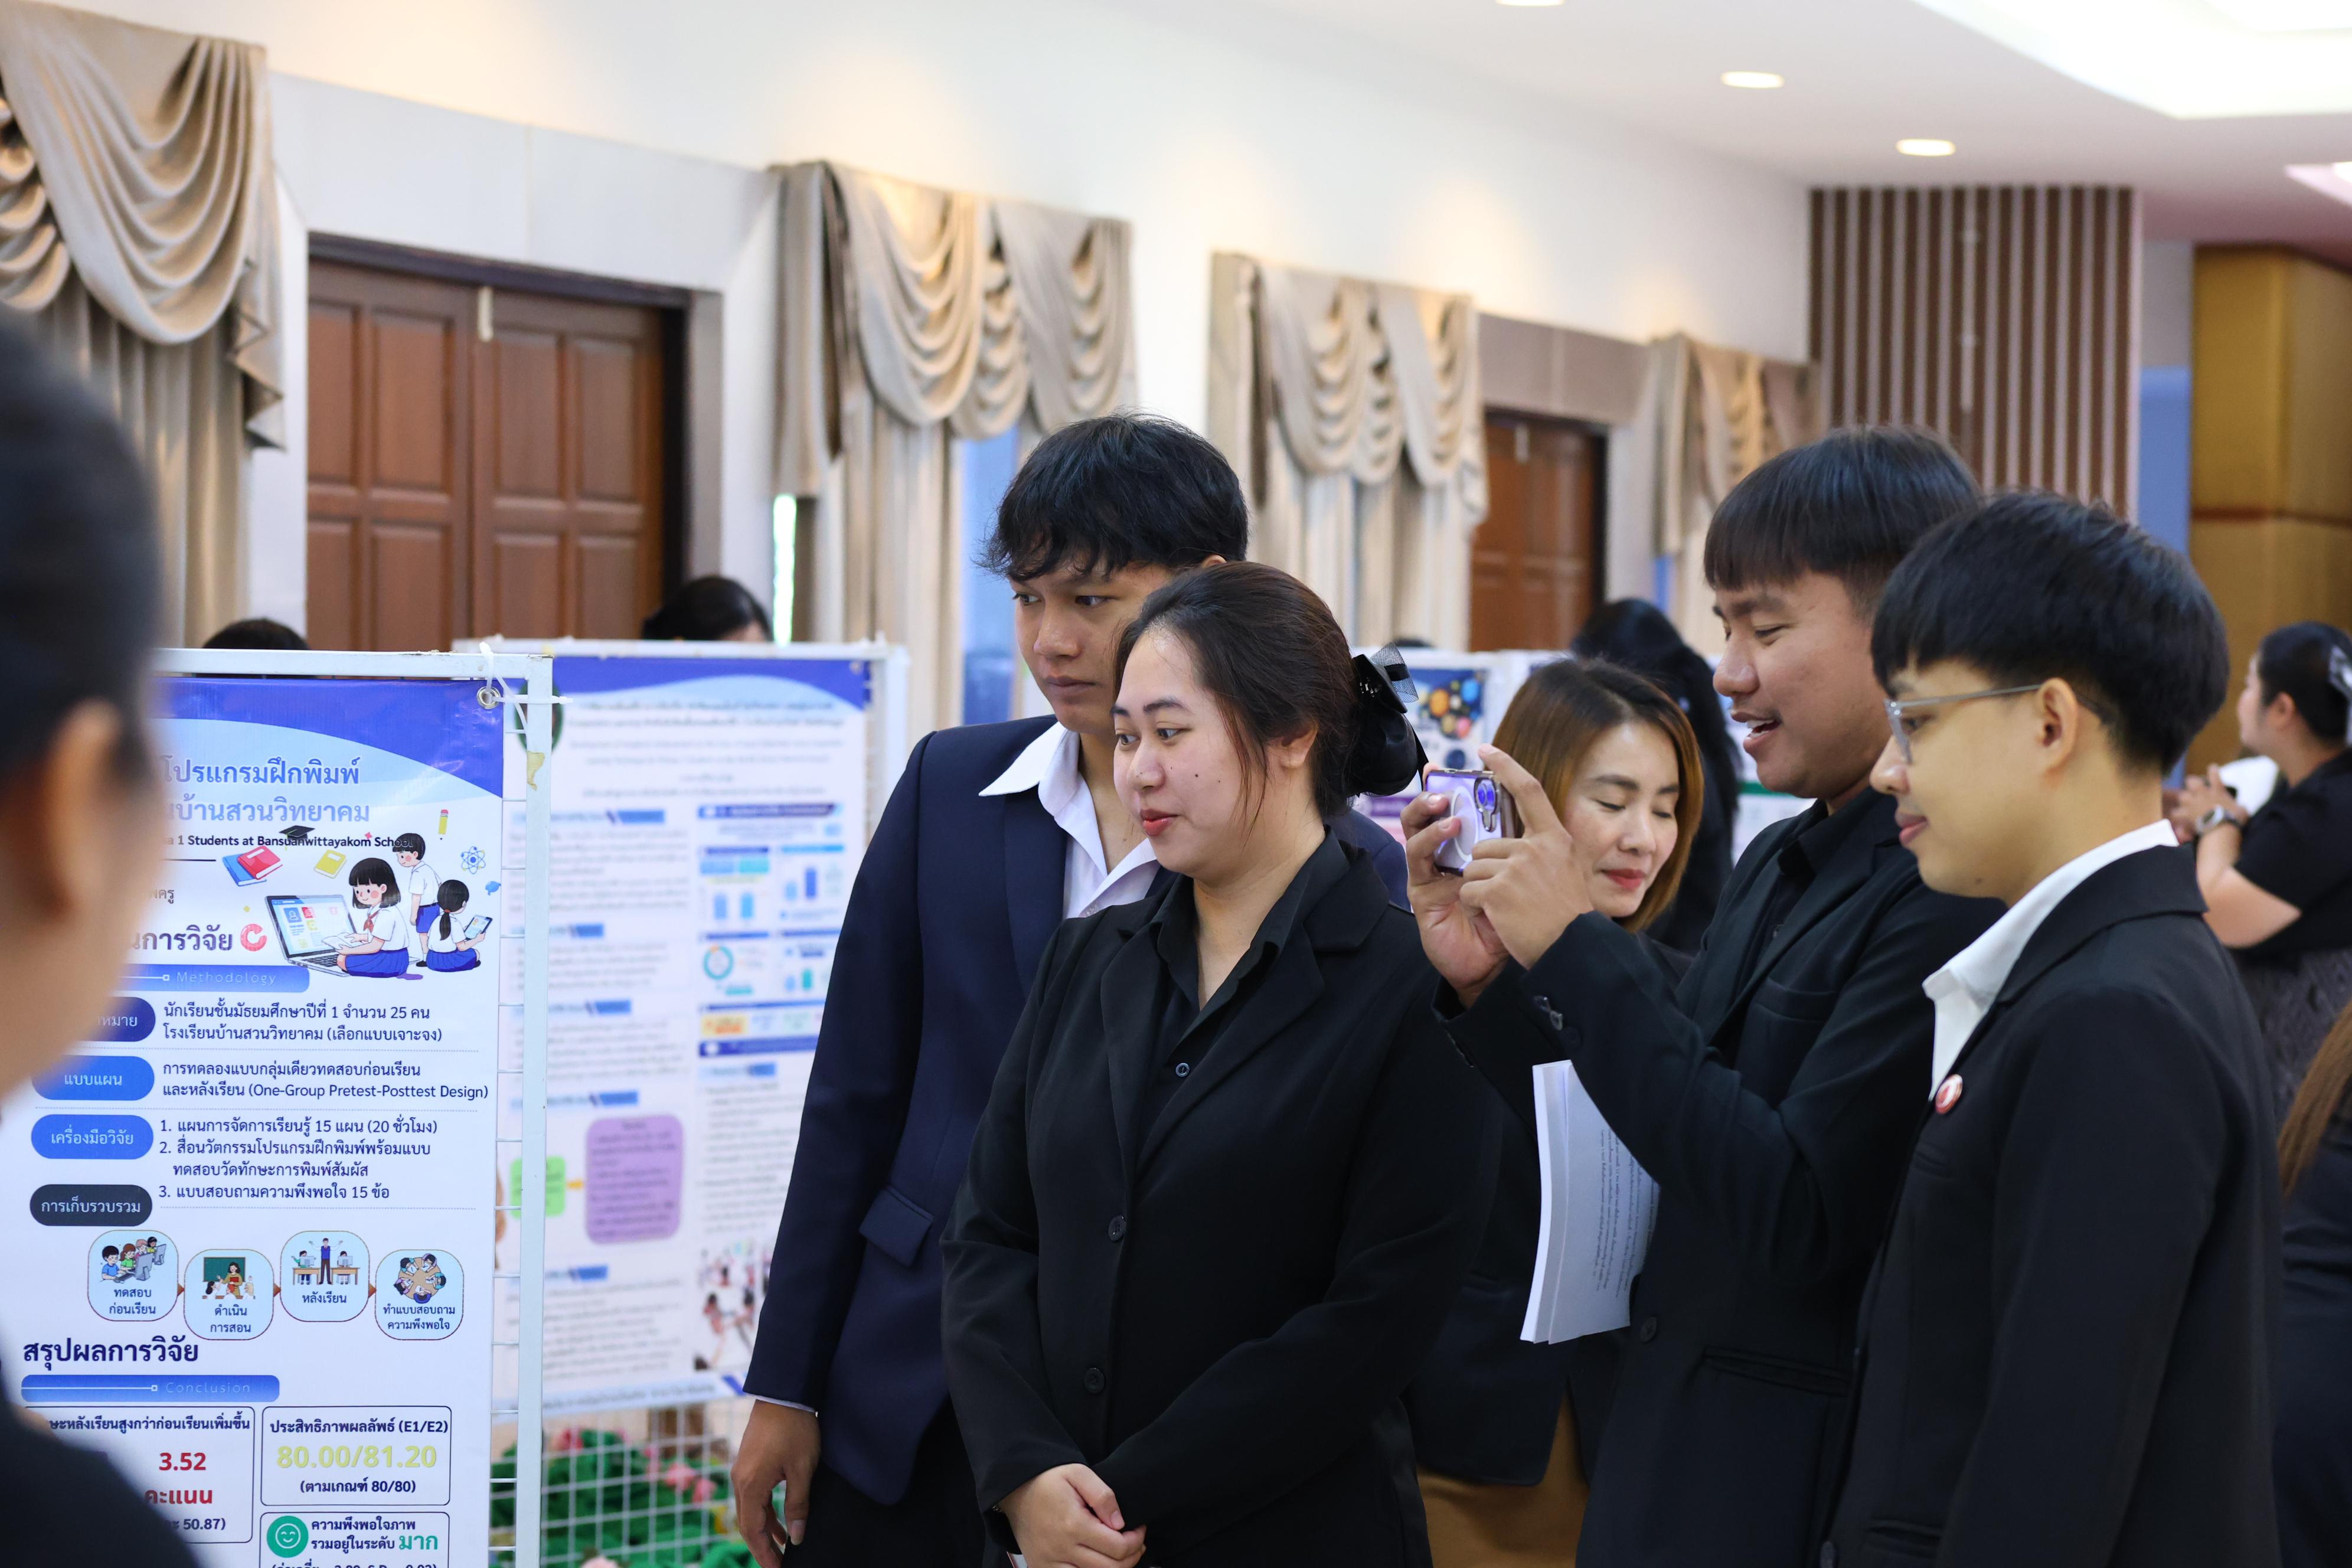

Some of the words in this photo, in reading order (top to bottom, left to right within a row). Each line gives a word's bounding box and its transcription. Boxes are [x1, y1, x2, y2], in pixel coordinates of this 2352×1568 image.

[168, 792, 370, 822] บ้านสวนวิทยาคม
[188, 835, 239, 846] Students
[242, 836, 254, 846] at
[257, 836, 371, 848] Bansuanwittayakom
[374, 837, 413, 848] School
[177, 971, 276, 986] Methodology
[164, 997, 326, 1019] นักเรียนชั้นมัธยมศึกษาปีที่
[332, 1006, 338, 1018] 1
[343, 1003, 386, 1019] จำนวน
[391, 1006, 407, 1019] 25
[411, 1008, 430, 1019] คน
[162, 1023, 323, 1040] โรงเรียนบ้านสวนวิทยาคม
[326, 1025, 443, 1042] (เลือกแบบเจาะจง)
[163, 1060, 421, 1080] การทดลองแบบกลุ่มเดียวทดสอบก่อนเรียน
[64, 1073, 123, 1086] แบบแผน
[163, 1080, 245, 1096] และหลังเรียน
[249, 1083, 325, 1100] (One-Group
[329, 1084, 436, 1098] Pretest-Posttest
[440, 1085, 489, 1101] Design)
[161, 1120, 172, 1132] 1.
[178, 1116, 311, 1137] แผนการจัดการเรียนรู้
[316, 1120, 331, 1132] 15
[335, 1121, 364, 1133] แผน
[367, 1120, 390, 1134] (20
[393, 1113, 437, 1134] ชั่วโมง)
[51, 1124, 135, 1145] เครื่องมือวิจัย
[159, 1142, 171, 1154] 2.
[177, 1134, 431, 1155] สื่อนวัตกรรมโปรแกรมฝึกพิมพ์พร้อมแบบ
[173, 1159, 368, 1177] ทดสอบวัดทักษะการพิมพ์สัมผัส
[159, 1185, 171, 1197] 3.
[177, 1182, 347, 1198] แบบสอบถามความพึงพอใจ
[352, 1186, 368, 1198] 15
[371, 1182, 390, 1198] ข้อ
[41, 1195, 141, 1213] การเก็บรวบรวม
[113, 1288, 152, 1298] ทดสอบ
[302, 1291, 347, 1304] หลังเรียน
[109, 1302, 156, 1315] ก่อนเรียน
[214, 1304, 247, 1316] ดำเนิน
[383, 1303, 456, 1315] ทำแบบสอบถาม
[210, 1323, 251, 1333] การสอน
[387, 1318, 450, 1330] ความพึงพอใจ
[23, 1335, 199, 1371] สรุปผลการวิจัย
[165, 1381, 250, 1394] Conclusion
[50, 1411, 250, 1434] ษะหลังเรียนสูงกว่าก่อนเรียนเพิ่มขึ้น
[269, 1417, 396, 1433] ประสิทธิภาพผลลัพธ์
[398, 1420, 448, 1433] (E1/E2)
[158, 1452, 207, 1471] 3.52
[276, 1445, 437, 1469] 80.00/81.20
[300, 1476, 368, 1492] (ตามเกณฑ์
[371, 1480, 416, 1492] 80/80)
[144, 1489, 213, 1504] คะแนน
[183, 1518, 226, 1531] 50.87)
[311, 1515, 416, 1530] ความพึงพอใจภาพ
[311, 1535, 395, 1554] รวมอยู่ในระดับ
[398, 1535, 438, 1550] มาก
